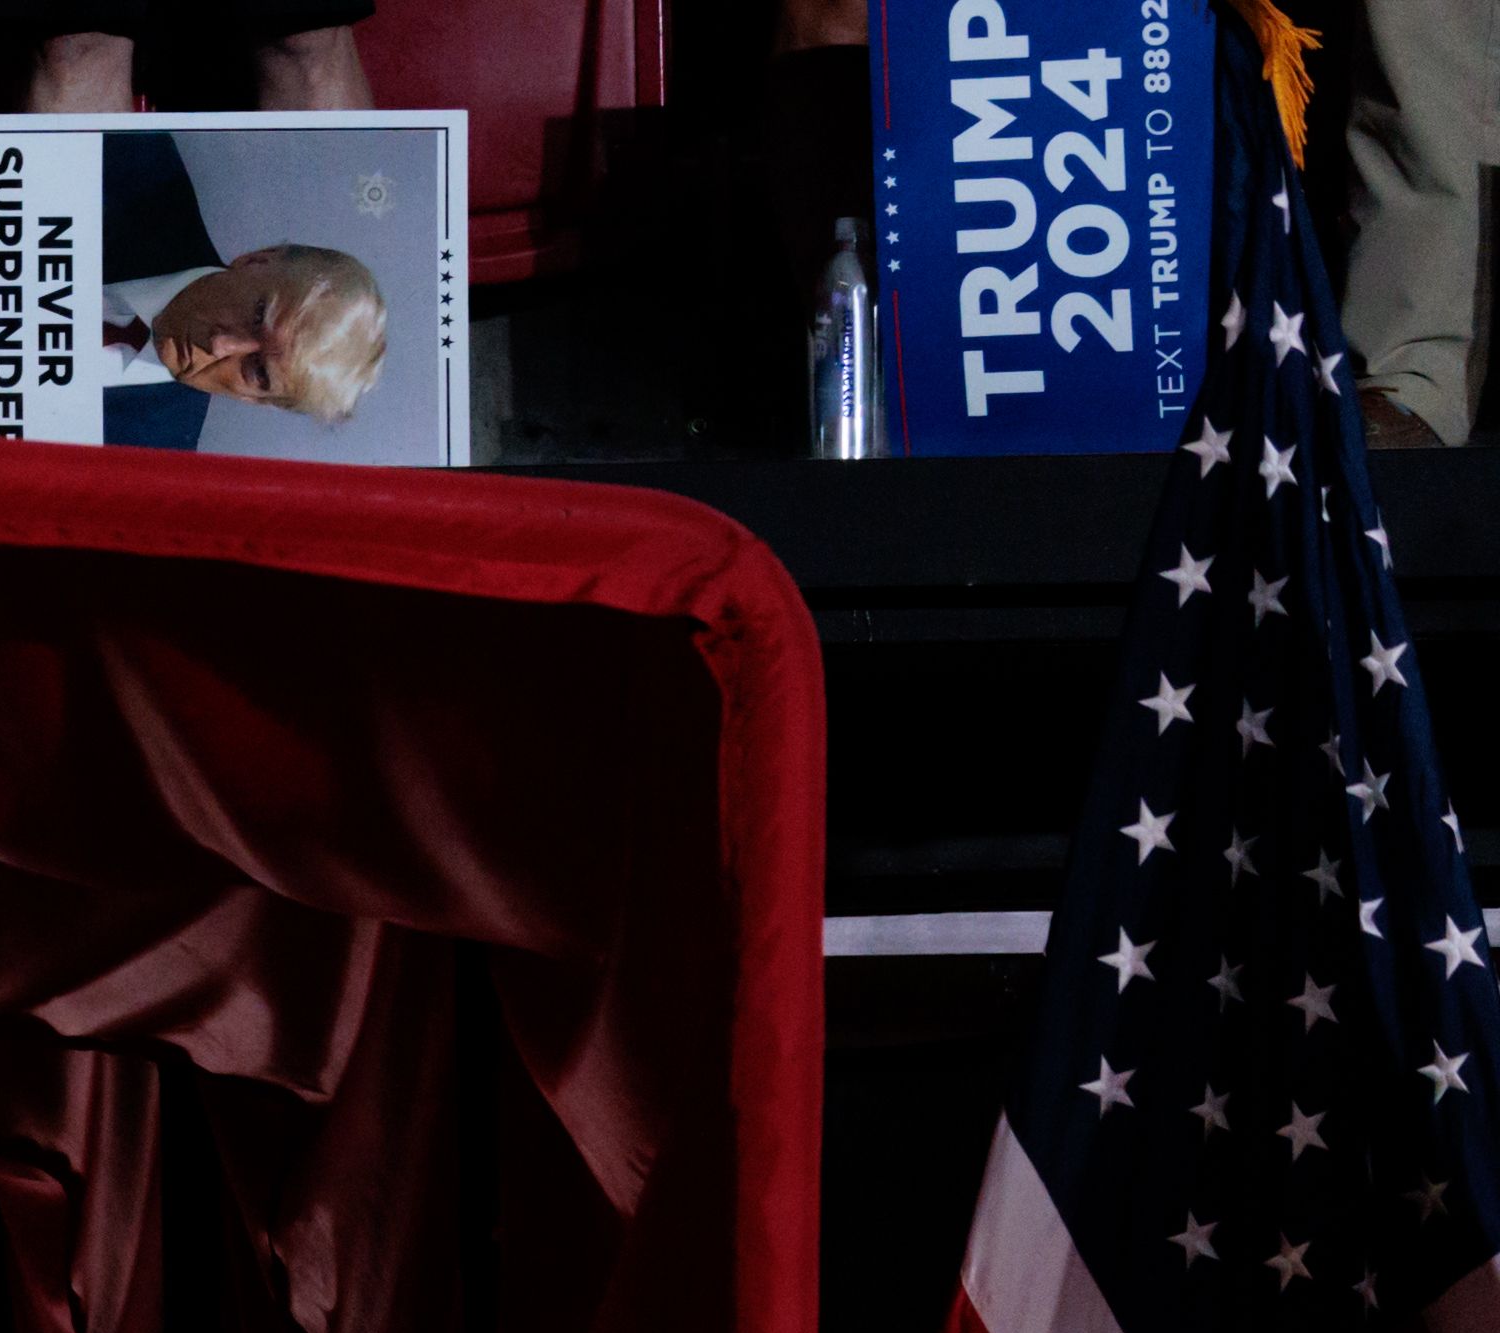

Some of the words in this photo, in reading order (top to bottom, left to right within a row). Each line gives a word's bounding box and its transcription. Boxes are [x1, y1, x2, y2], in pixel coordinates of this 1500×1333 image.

[1140, 0, 1172, 94] 8802
[1040, 47, 1134, 354] 2024
[1145, 108, 1173, 160] TO
[948, 0, 1045, 417] TRUMP
[1147, 172, 1180, 310] TRUMP
[38, 216, 73, 386] NEVER
[1153, 323, 1186, 419] TEXT
